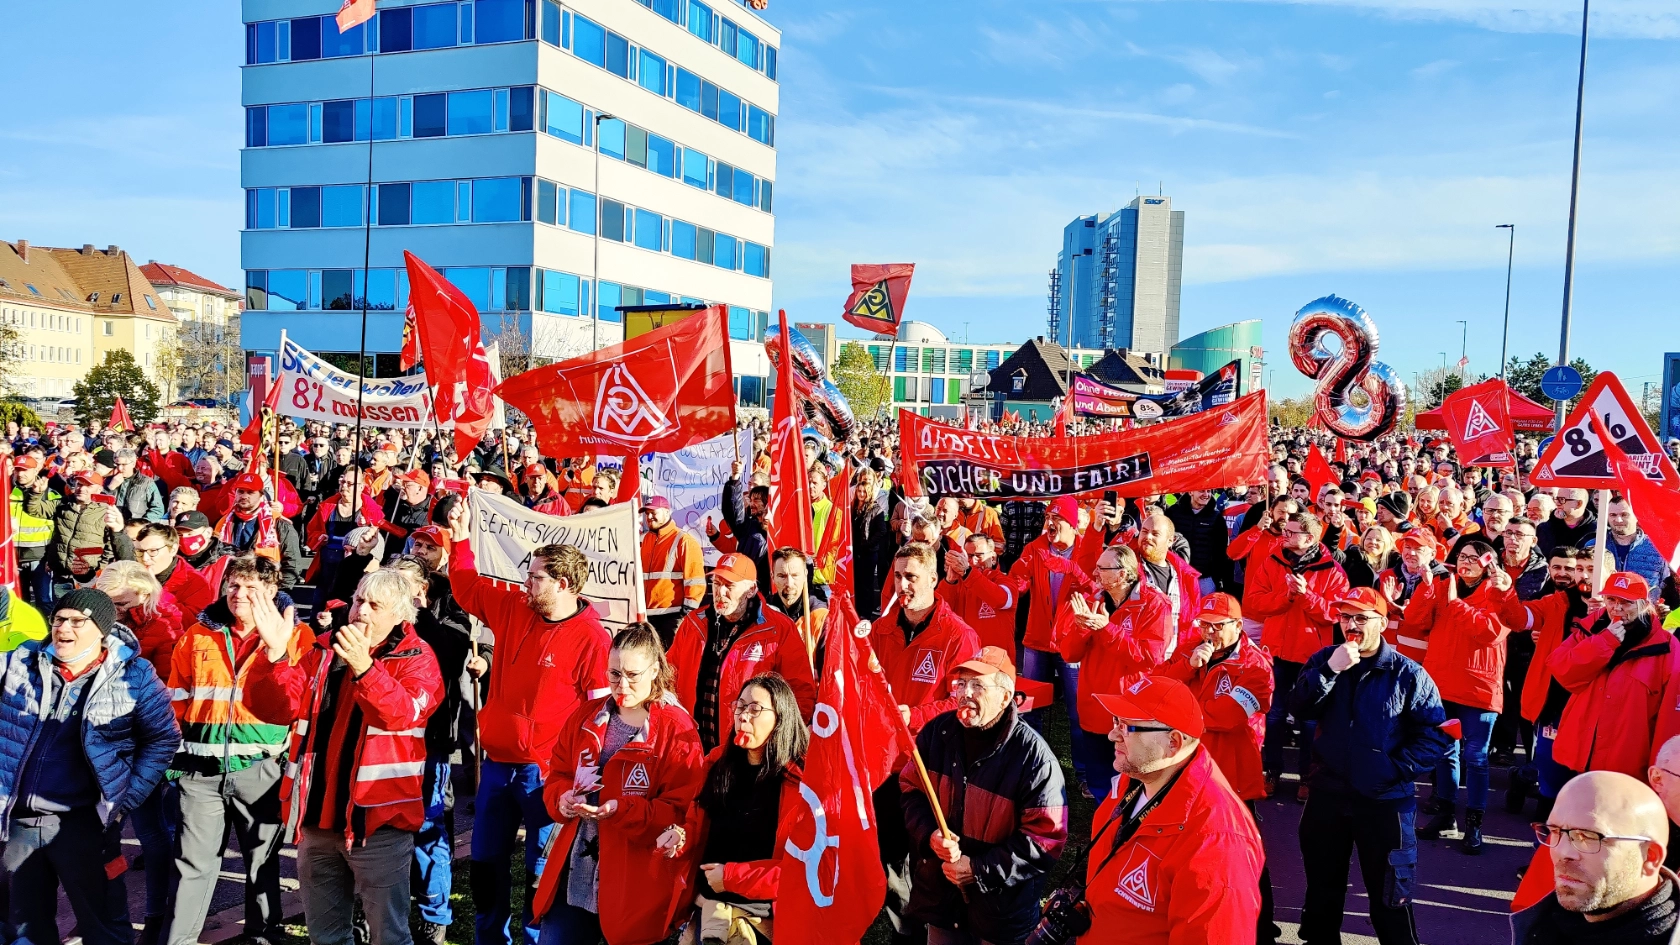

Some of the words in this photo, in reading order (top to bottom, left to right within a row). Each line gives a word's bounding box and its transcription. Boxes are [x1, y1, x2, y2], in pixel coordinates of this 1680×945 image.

[292, 377, 326, 412] 8%
[332, 398, 419, 422] müssen
[1075, 400, 1094, 411] und
[1076, 381, 1100, 395] Ohne
[919, 424, 1009, 460] ARBEIT:
[656, 455, 678, 485] Tag
[685, 466, 708, 486] und
[922, 466, 1003, 495] SICHER
[1012, 471, 1062, 492] UND
[1073, 458, 1142, 490] FAIR!
[479, 509, 619, 553] GEHALTSVOLUMEN
